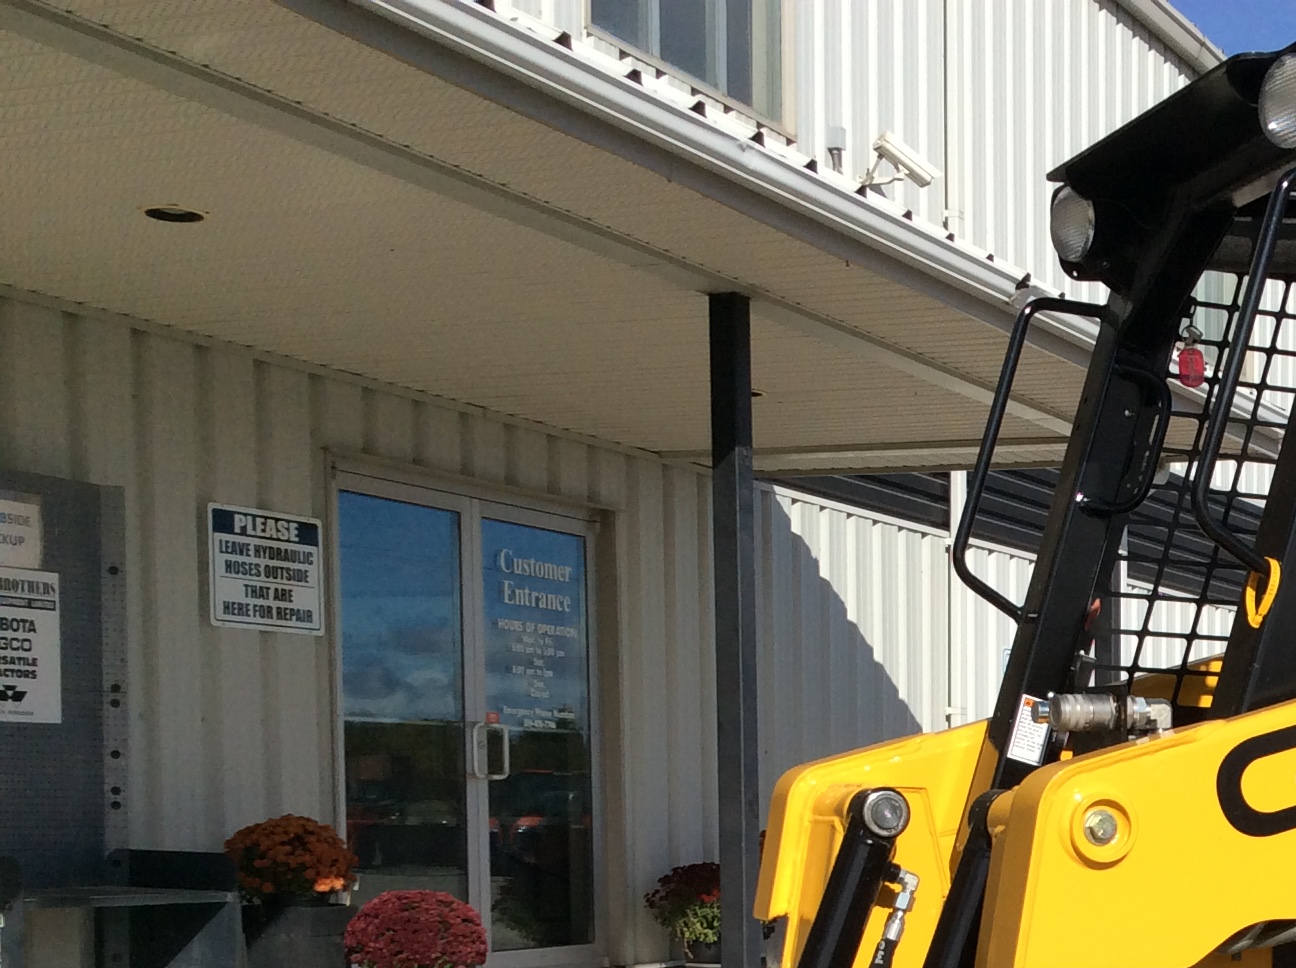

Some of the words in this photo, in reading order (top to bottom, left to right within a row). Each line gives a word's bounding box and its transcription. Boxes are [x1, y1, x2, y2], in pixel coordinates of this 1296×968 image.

[233, 513, 300, 542] PLEASE
[218, 539, 251, 558] LEAVE
[253, 543, 314, 566] HYDRAULIC
[225, 559, 261, 578] HOSES
[264, 564, 309, 583] OUTSIDE
[500, 549, 573, 582] Customer
[243, 584, 270, 600] THAT
[273, 587, 294, 603] ARE
[503, 580, 571, 612] Entrance
[222, 600, 251, 617] HERE
[253, 603, 273, 620] FOR
[276, 606, 313, 623] REPAIR
[498, 618, 523, 632] HOURS
[526, 622, 536, 633] OF
[537, 623, 578, 638] OPERATION
